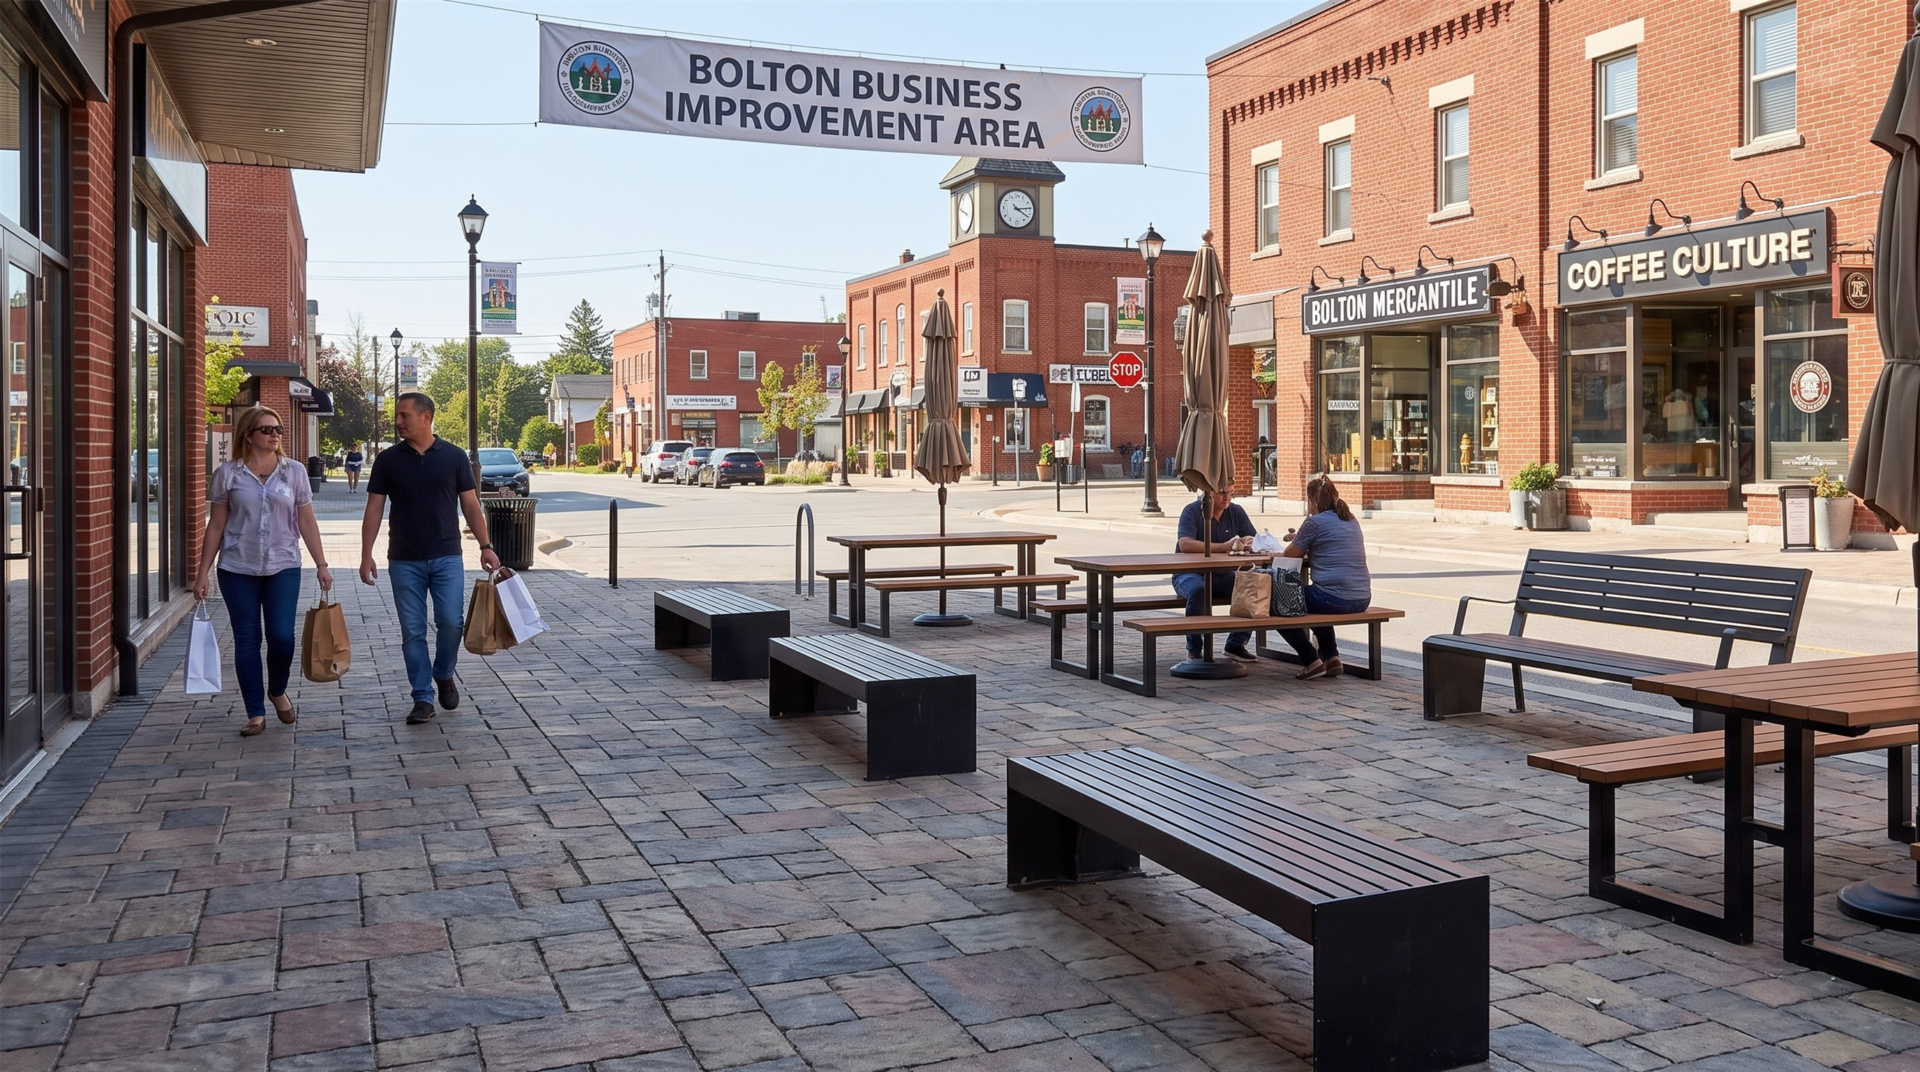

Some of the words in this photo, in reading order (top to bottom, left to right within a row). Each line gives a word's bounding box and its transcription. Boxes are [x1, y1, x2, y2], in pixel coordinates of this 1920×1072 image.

[689, 53, 840, 98] BOLTON
[852, 69, 1022, 112] BUSINESS
[665, 90, 945, 144] IMPROVEMENT
[953, 116, 1046, 150] AREA
[1567, 249, 1667, 291] COFFEE
[1672, 227, 1812, 278] CULTURE
[1311, 292, 1367, 326] BOLTON
[1373, 275, 1478, 318] MERCANTILE
[1111, 363, 1141, 376] STOP
